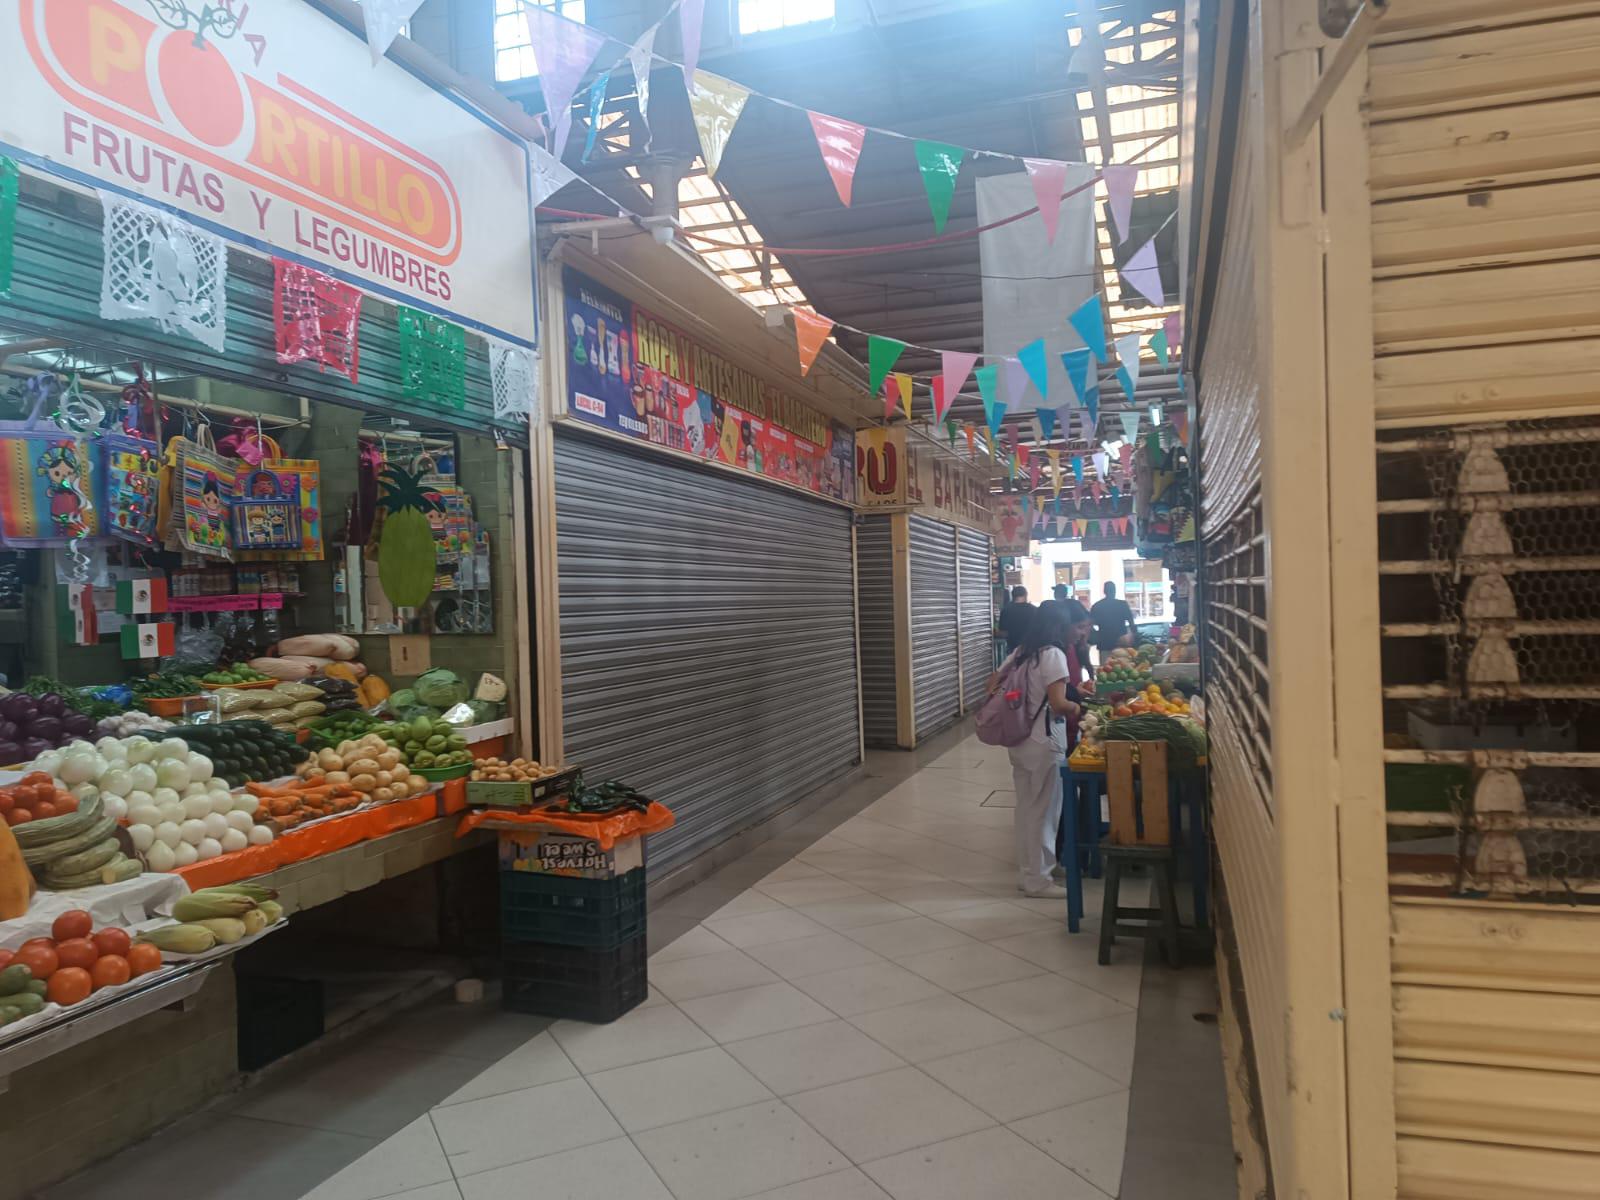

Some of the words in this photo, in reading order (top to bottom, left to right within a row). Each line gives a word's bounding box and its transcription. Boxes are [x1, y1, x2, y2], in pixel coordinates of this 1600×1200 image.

[64, 112, 226, 214] FRUTAS
[250, 190, 272, 231] Y
[294, 208, 452, 302] LEGUMBRES
[637, 312, 681, 380] ROPA
[680, 335, 690, 385] Y
[906, 447, 922, 501] EL
[543, 854, 606, 871] Harvest
[544, 842, 597, 857] Sweet
